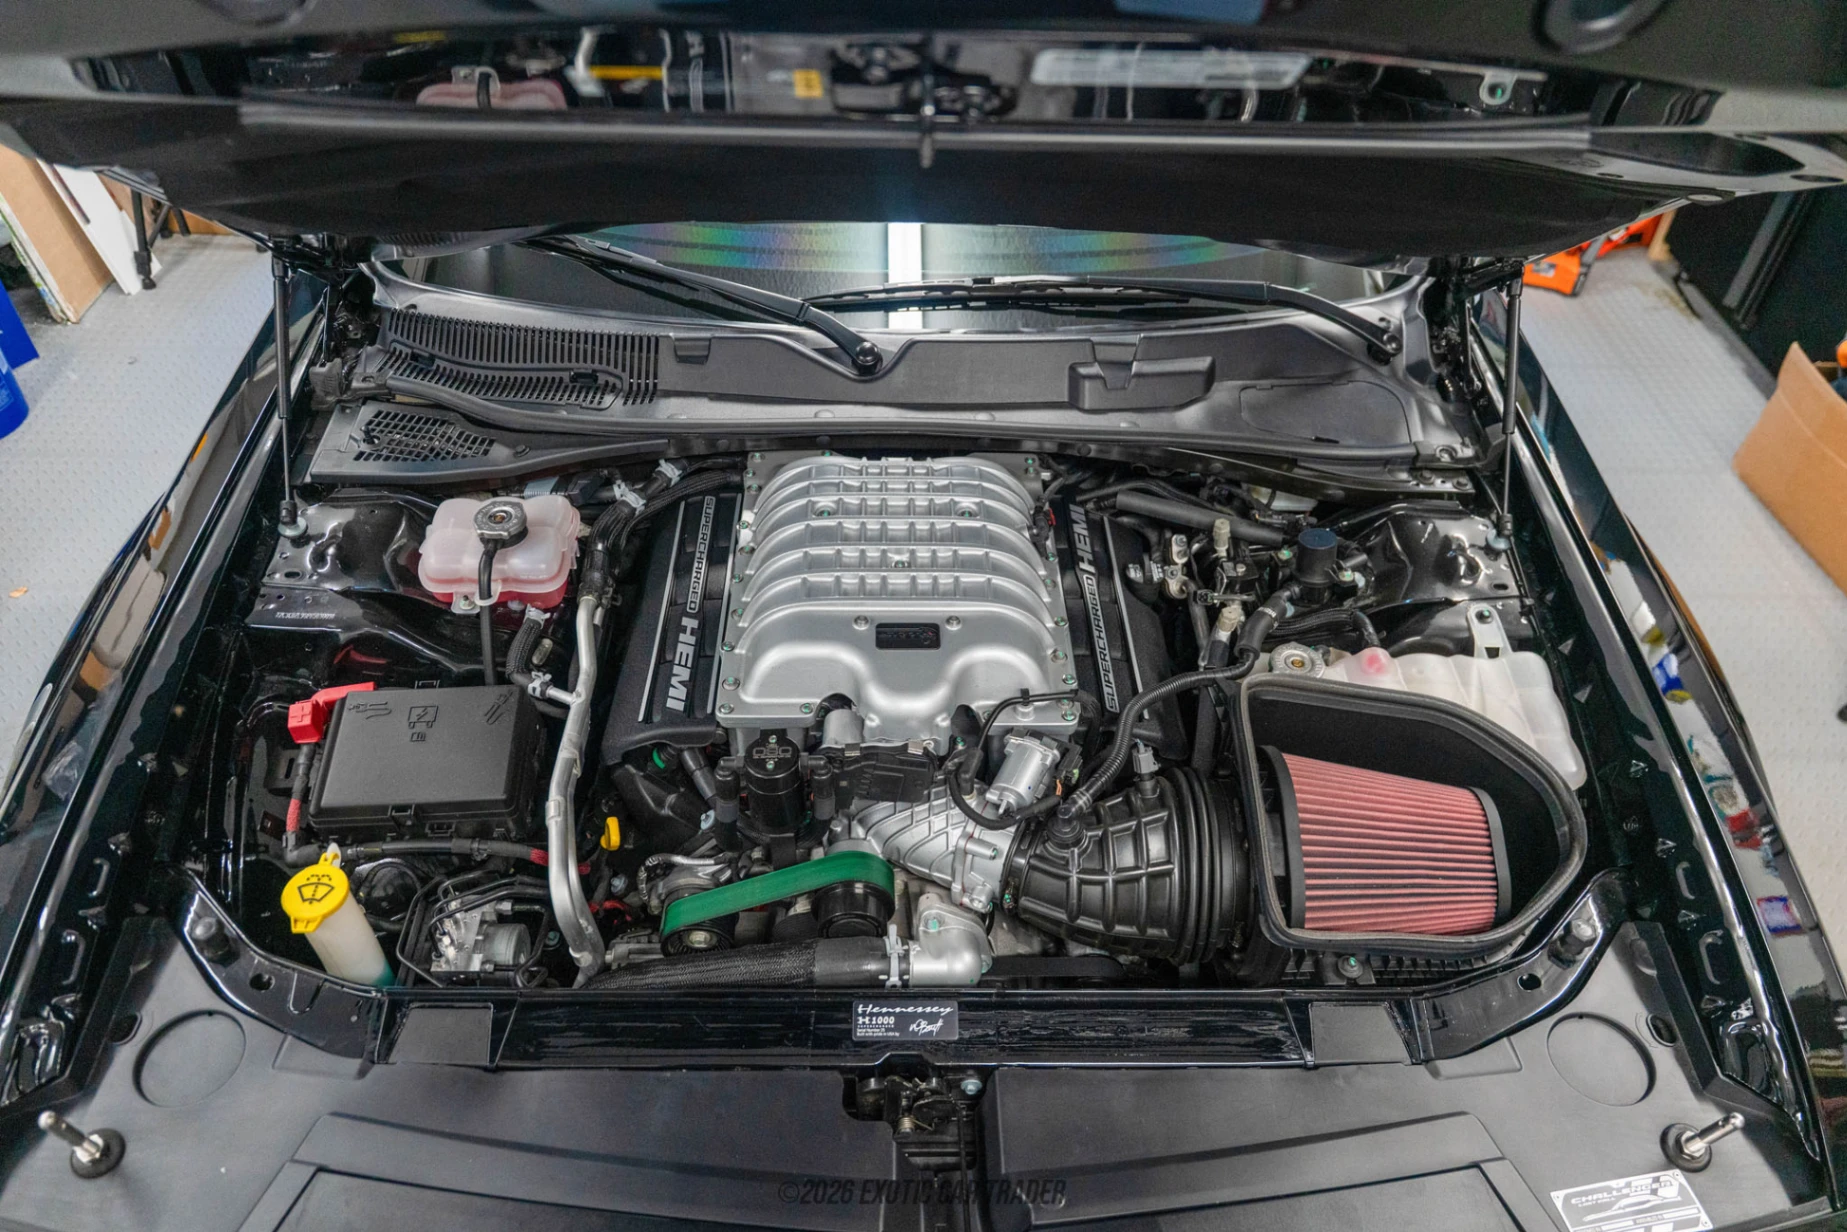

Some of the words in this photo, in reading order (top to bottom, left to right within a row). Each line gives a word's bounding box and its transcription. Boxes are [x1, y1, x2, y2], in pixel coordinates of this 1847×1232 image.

[688, 497, 715, 611] SUPERCHARGED
[1069, 503, 1096, 574] HEMI
[666, 616, 699, 711] HEMI
[1084, 575, 1119, 713] SUPERCHARGED
[857, 1003, 954, 1016] Hennessey
[1570, 1180, 1673, 1205] CHALLENGER
